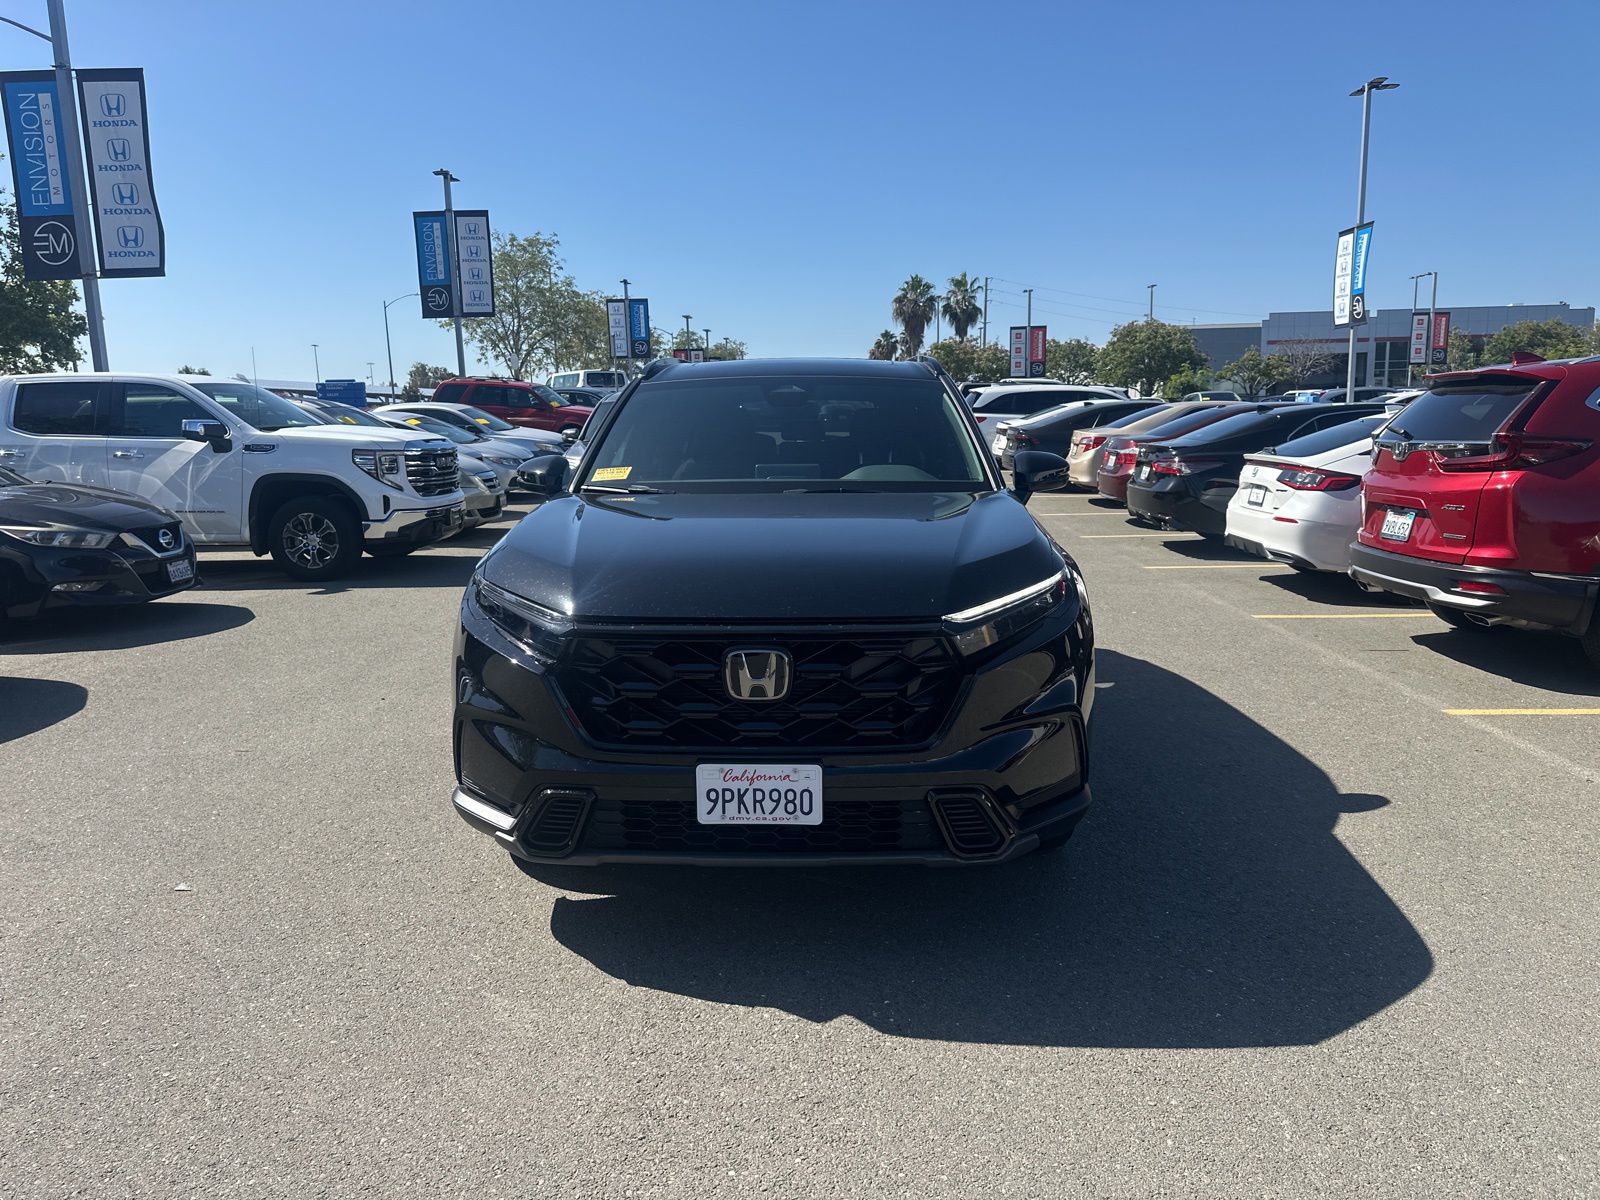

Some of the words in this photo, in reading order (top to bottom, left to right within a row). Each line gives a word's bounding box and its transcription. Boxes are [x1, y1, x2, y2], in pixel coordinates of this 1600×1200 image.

[92, 119, 138, 128] HONDA
[17, 93, 50, 206] ENVISION
[42, 103, 61, 196] MOTORS
[98, 164, 143, 172] HONDA
[103, 207, 152, 216] HONDA
[108, 250, 156, 258] HONDA
[423, 222, 438, 281] ENVISION
[722, 768, 799, 786] California
[705, 787, 813, 816] 9PKR980
